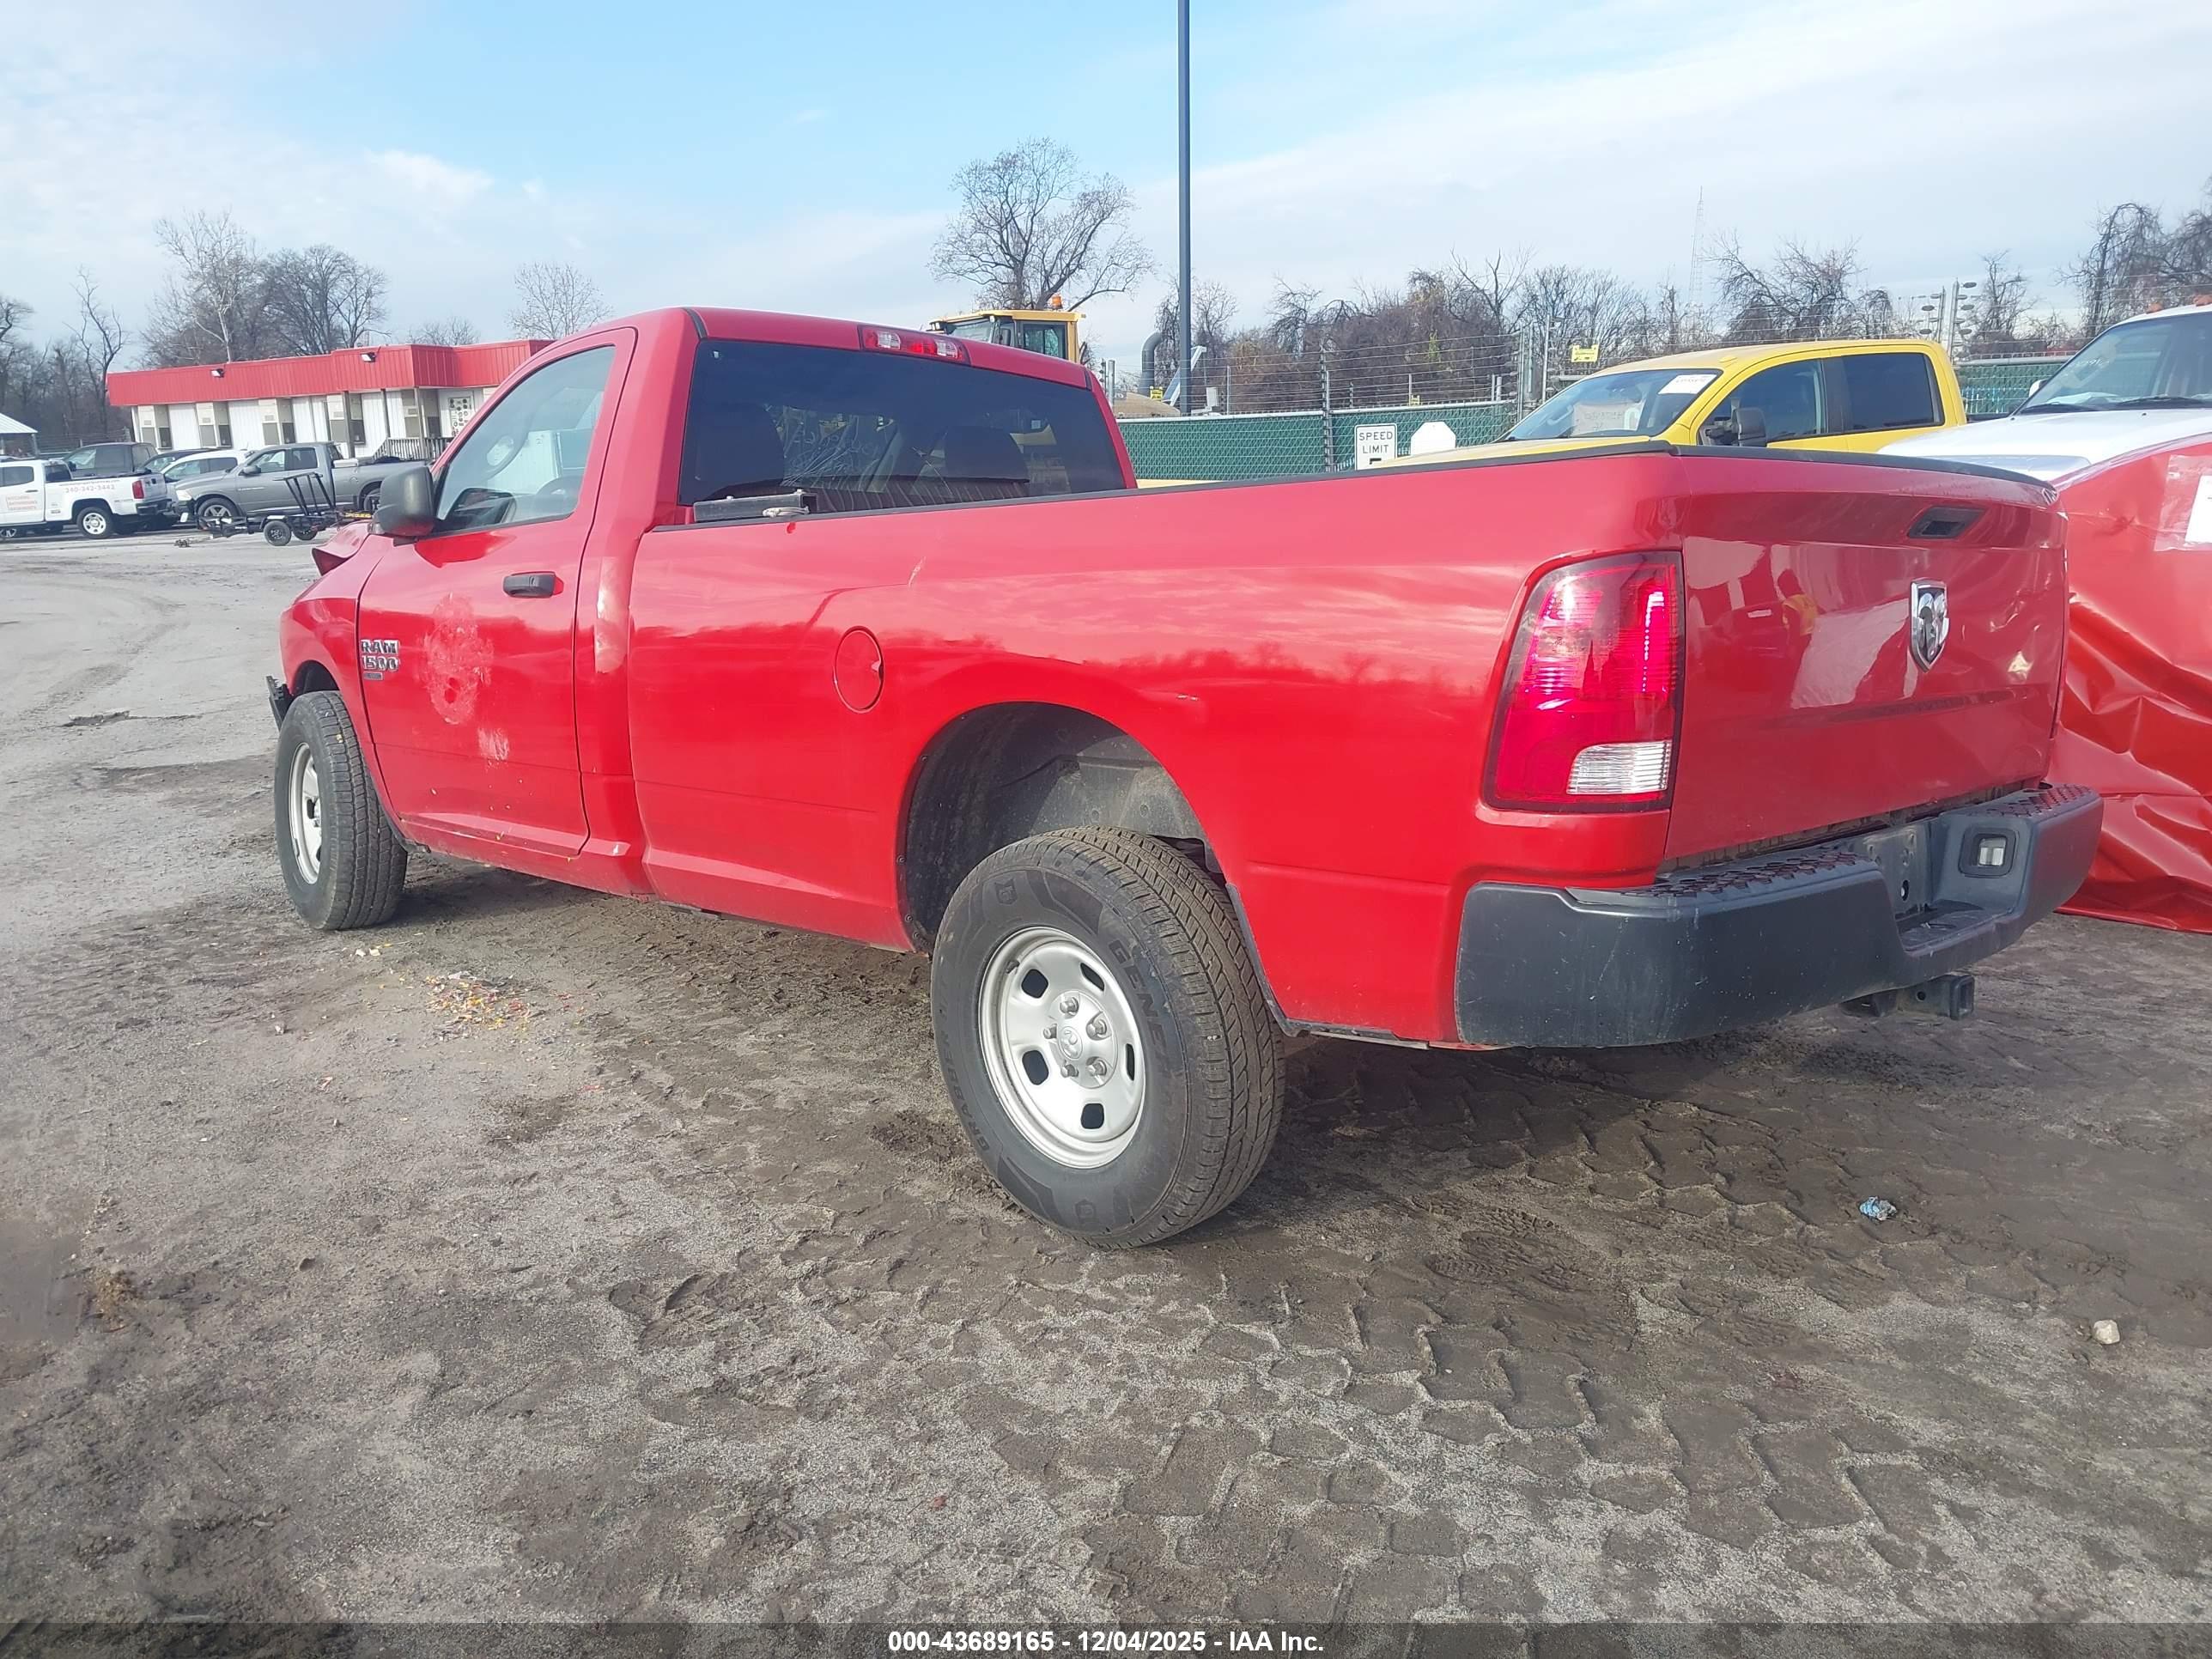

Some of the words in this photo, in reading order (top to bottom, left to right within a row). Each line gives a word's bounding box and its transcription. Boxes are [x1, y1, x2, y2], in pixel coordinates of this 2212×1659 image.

[1358, 431, 1393, 441] SPEED
[1362, 445, 1389, 453] LIMIT
[361, 639, 399, 654] RAM
[362, 655, 399, 671] 1500
